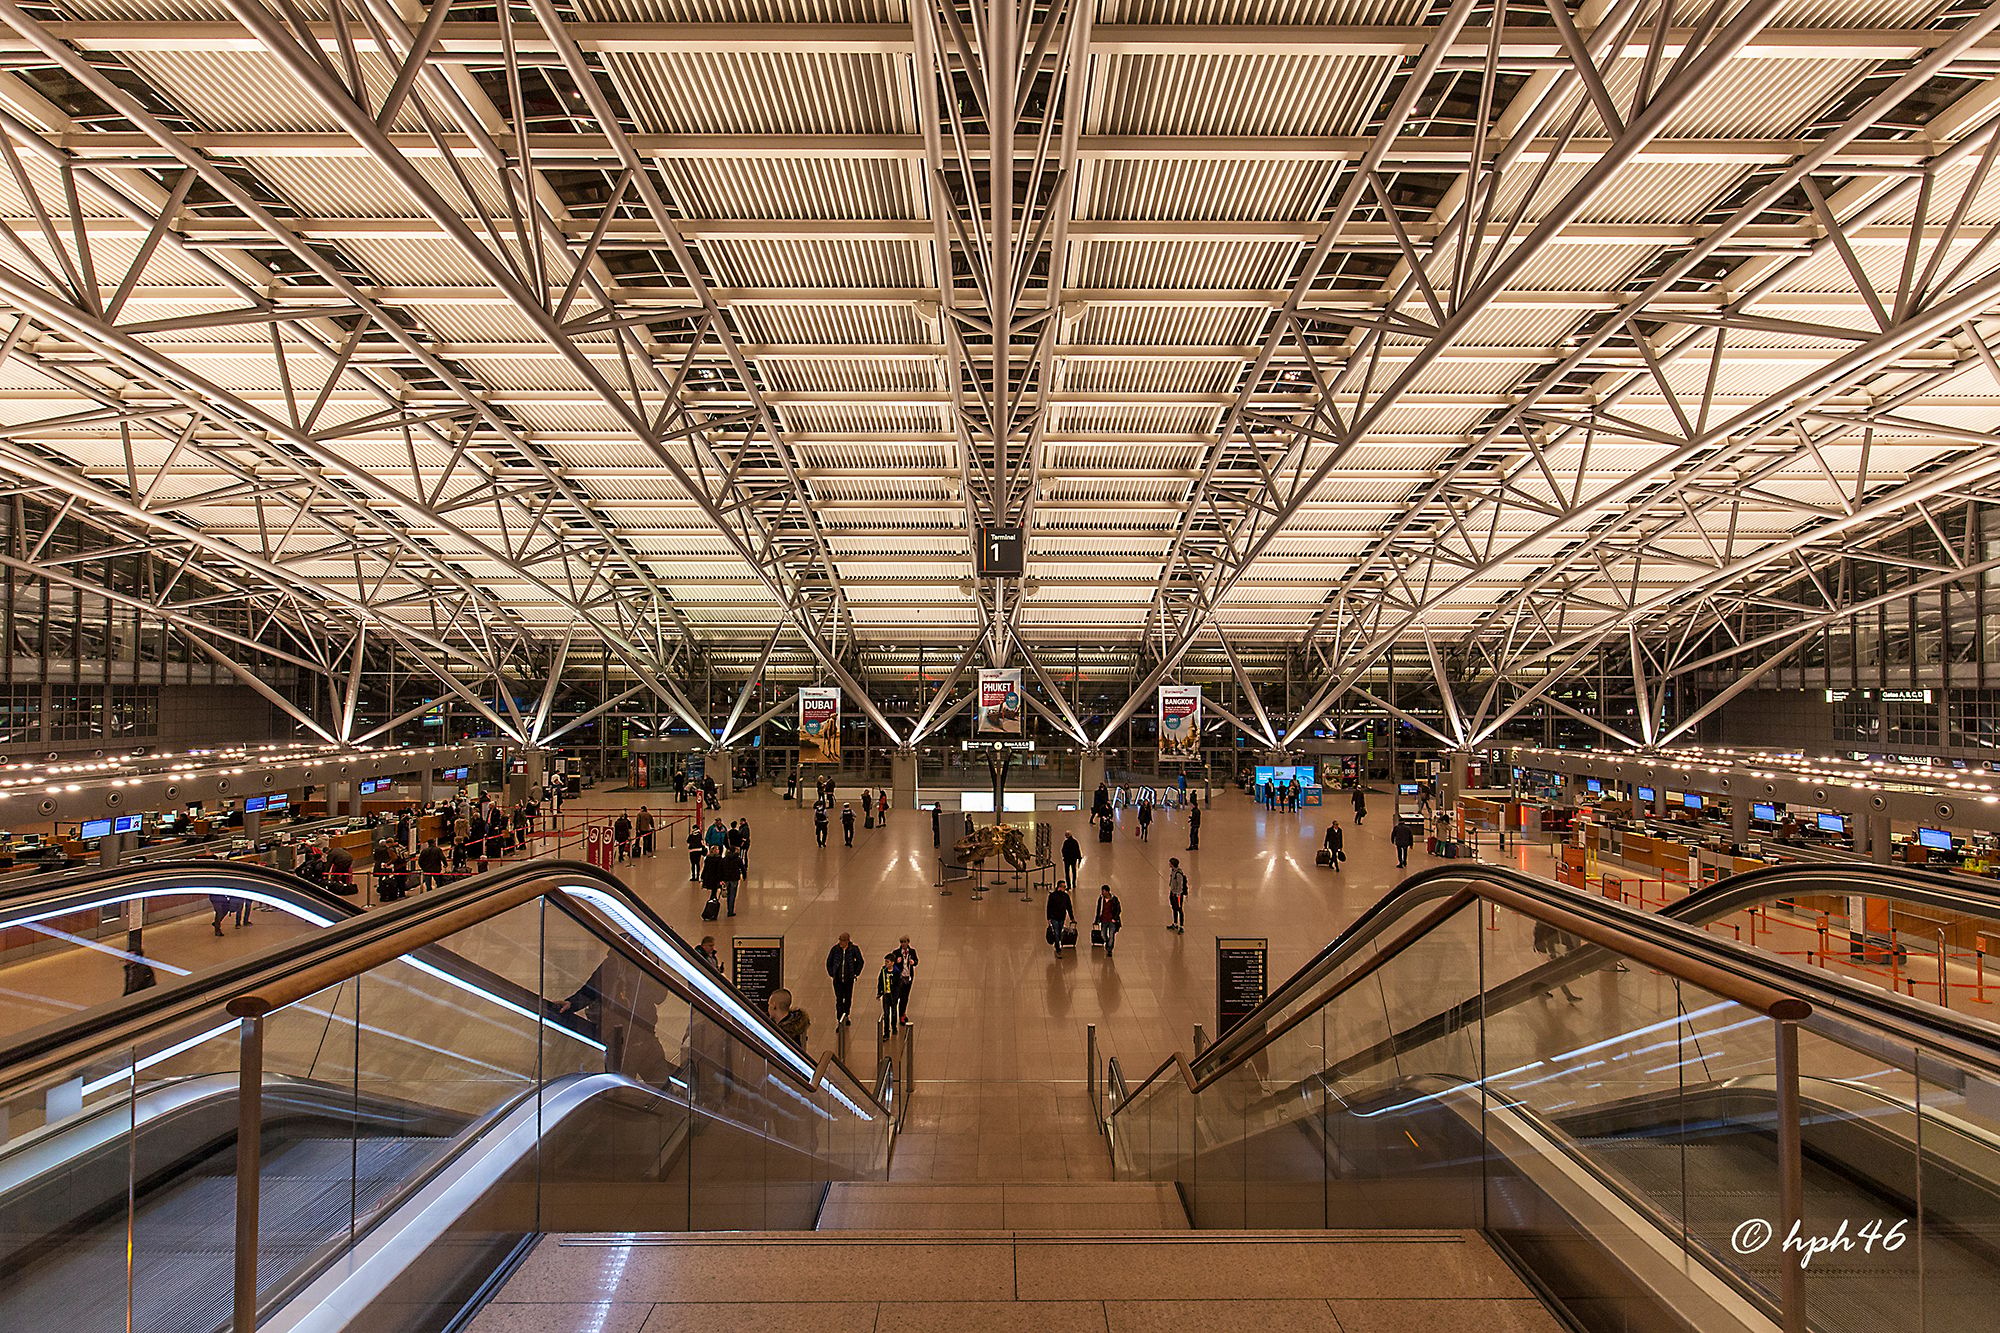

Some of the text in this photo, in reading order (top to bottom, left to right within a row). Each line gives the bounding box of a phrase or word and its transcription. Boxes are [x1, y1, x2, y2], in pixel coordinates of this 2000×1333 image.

[991, 543, 999, 562] 1
[984, 683, 1011, 692] PHUKET
[804, 700, 833, 710] DUBAI
[496, 748, 503, 757] 2
[1492, 750, 1500, 759] 3
